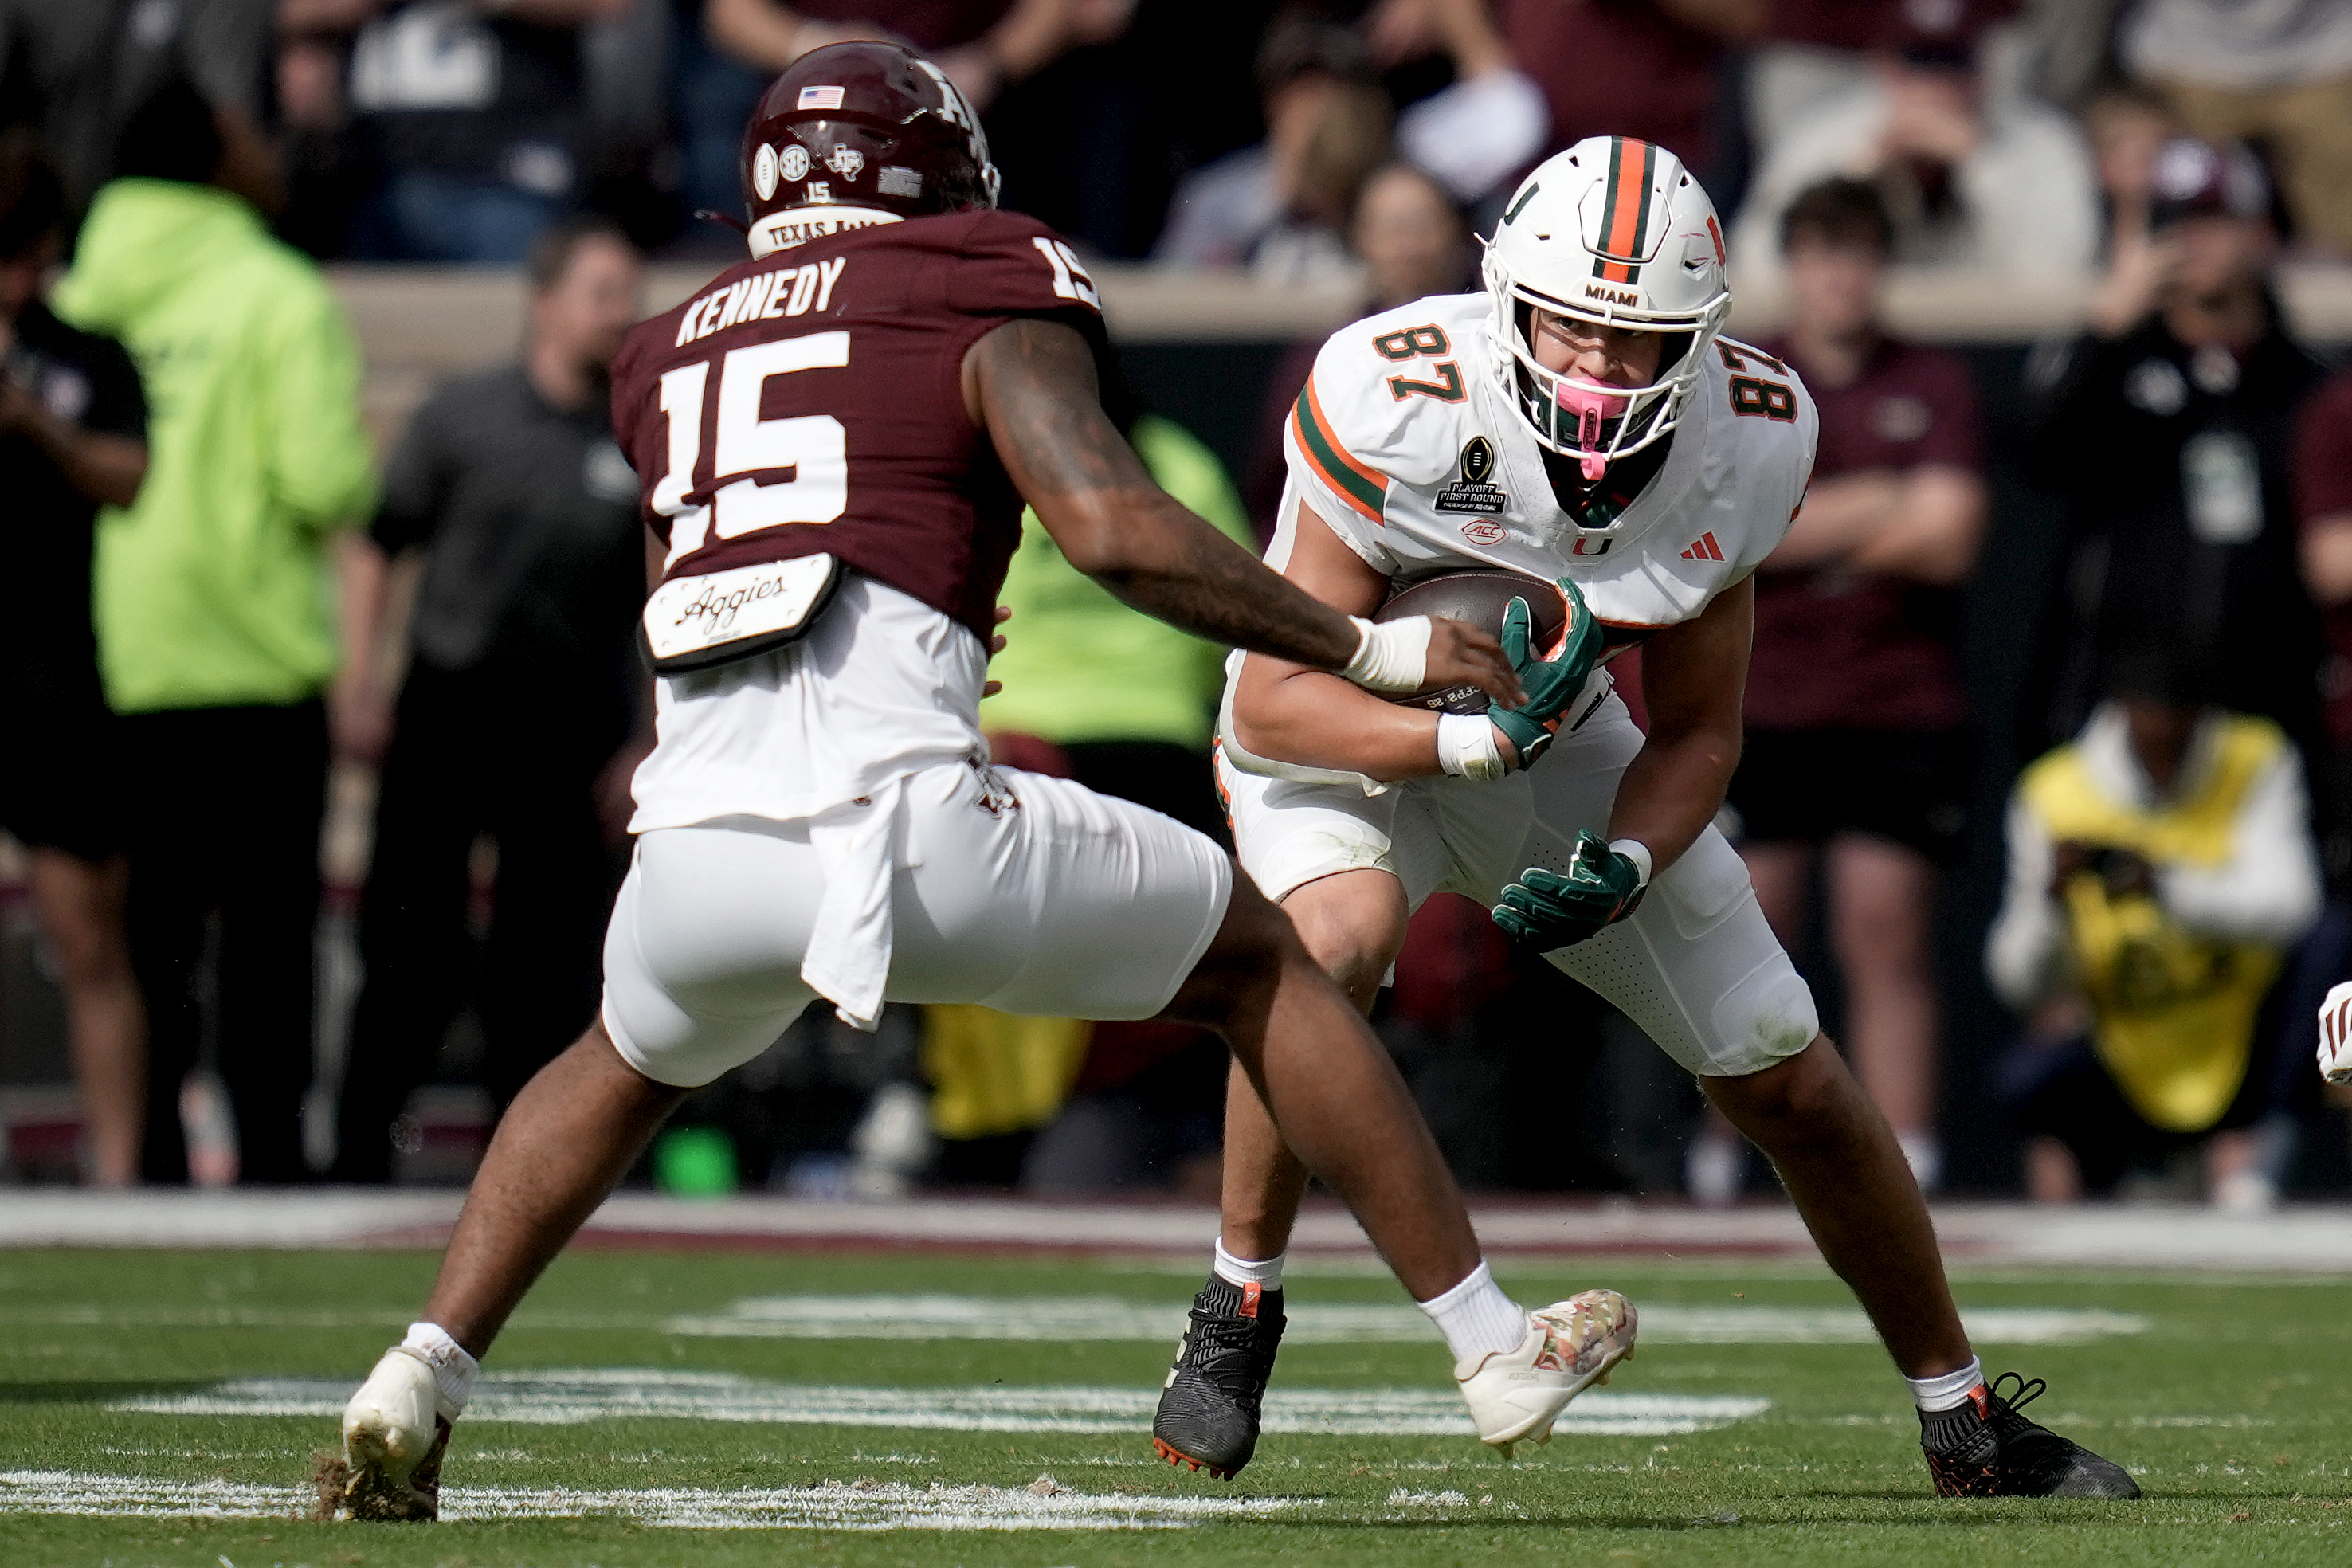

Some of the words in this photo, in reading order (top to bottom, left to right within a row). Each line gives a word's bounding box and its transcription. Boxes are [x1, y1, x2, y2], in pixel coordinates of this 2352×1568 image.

[807, 181, 830, 203] 15
[768, 221, 826, 247] TEXAS
[1032, 236, 1103, 311] 15
[675, 257, 847, 348] KENNEDY
[1585, 284, 1638, 308] MIAMI
[1371, 323, 1469, 405] 87
[1714, 339, 1799, 425] 87
[650, 330, 850, 578] 15
[1440, 492, 1469, 501] FIRST
[1470, 493, 1503, 503] ROUND
[1452, 484, 1495, 493] PLAYOFF
[1468, 525, 1502, 536] ACC
[1572, 537, 1614, 557] U
[674, 575, 789, 636] Aggies
